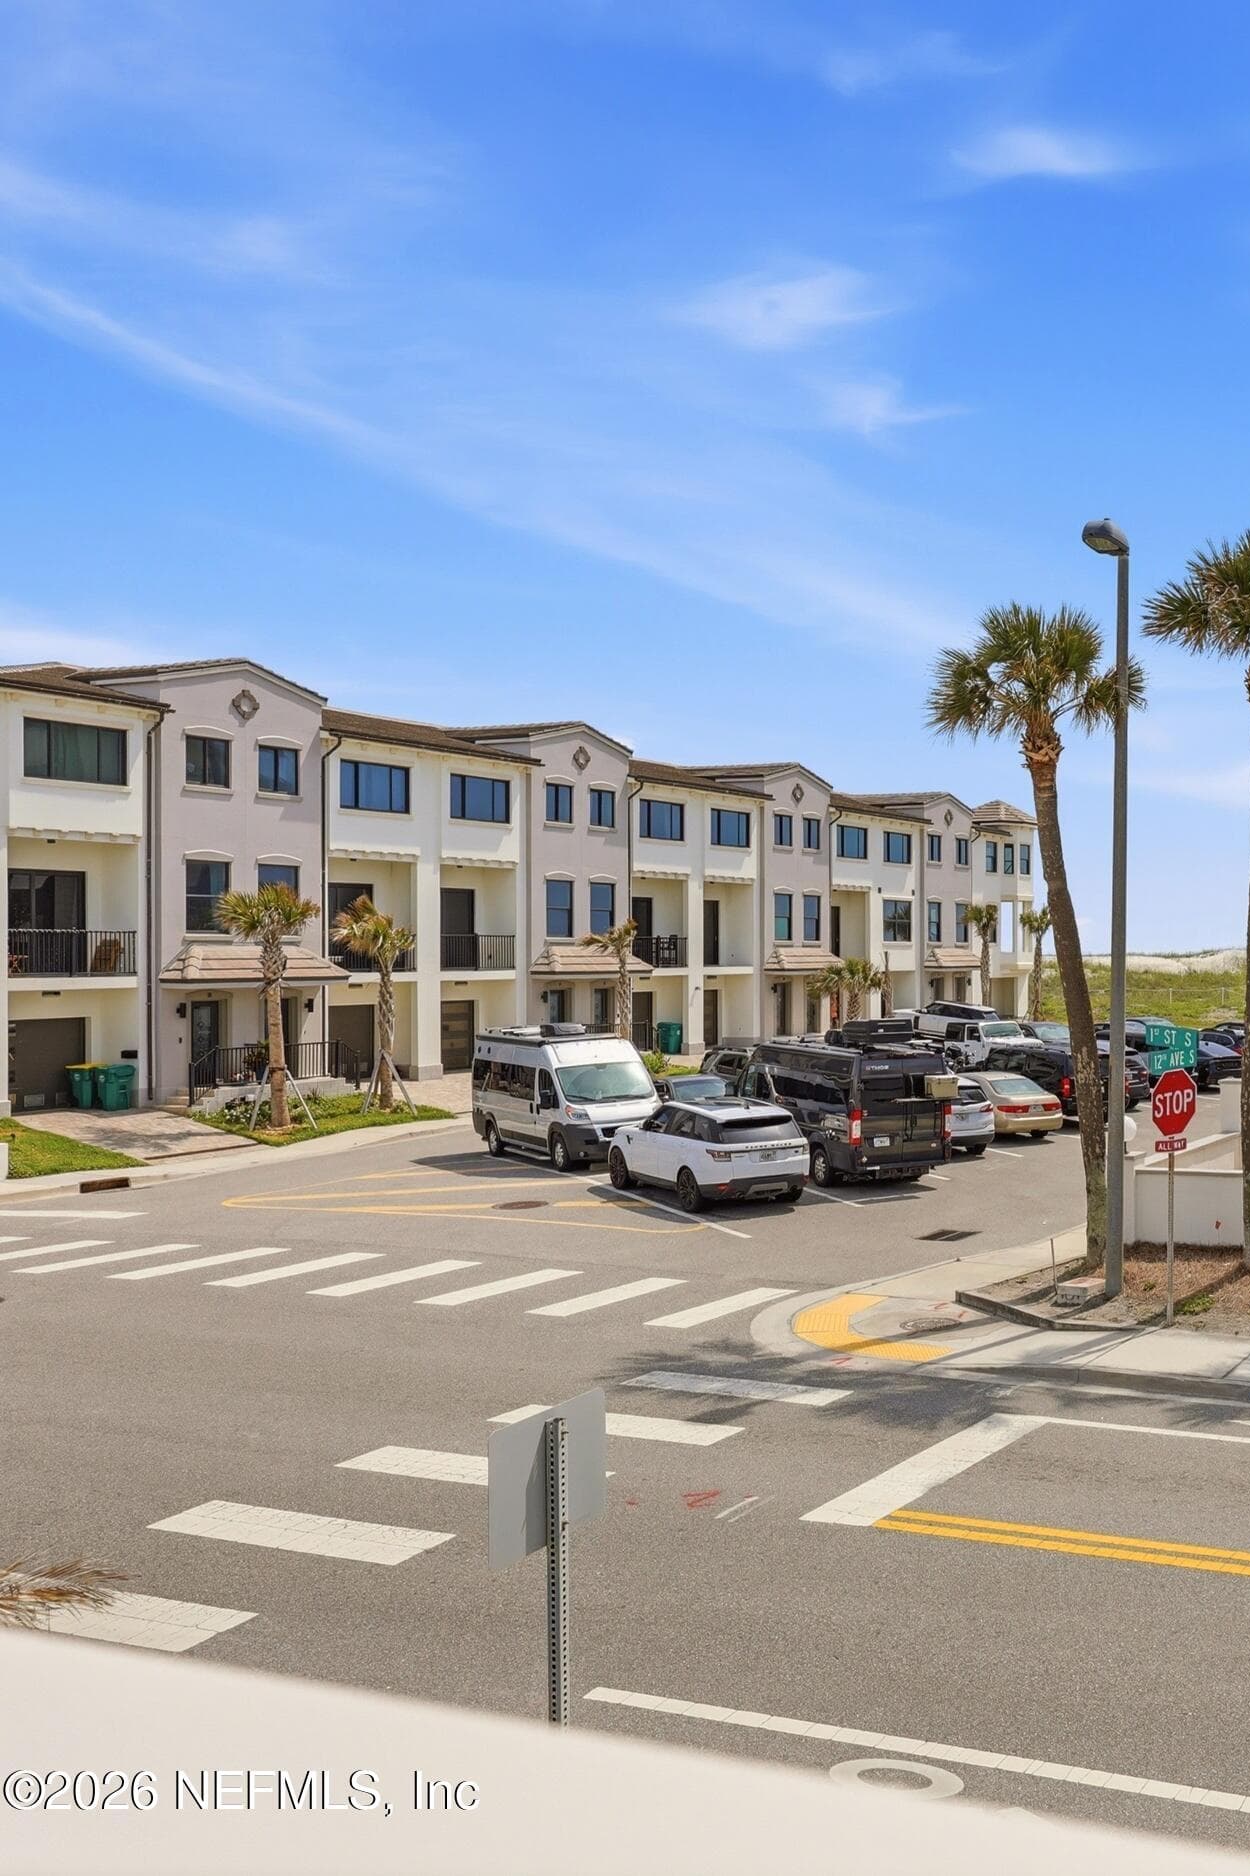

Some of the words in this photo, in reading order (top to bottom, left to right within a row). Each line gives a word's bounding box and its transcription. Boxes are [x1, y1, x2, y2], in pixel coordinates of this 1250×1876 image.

[1164, 1029, 1176, 1045] ST
[1184, 1032, 1191, 1047] S
[1169, 1051, 1185, 1067] AVE
[1189, 1049, 1195, 1064] S
[1155, 1089, 1193, 1118] STOP
[1157, 1142, 1173, 1151] ALL
